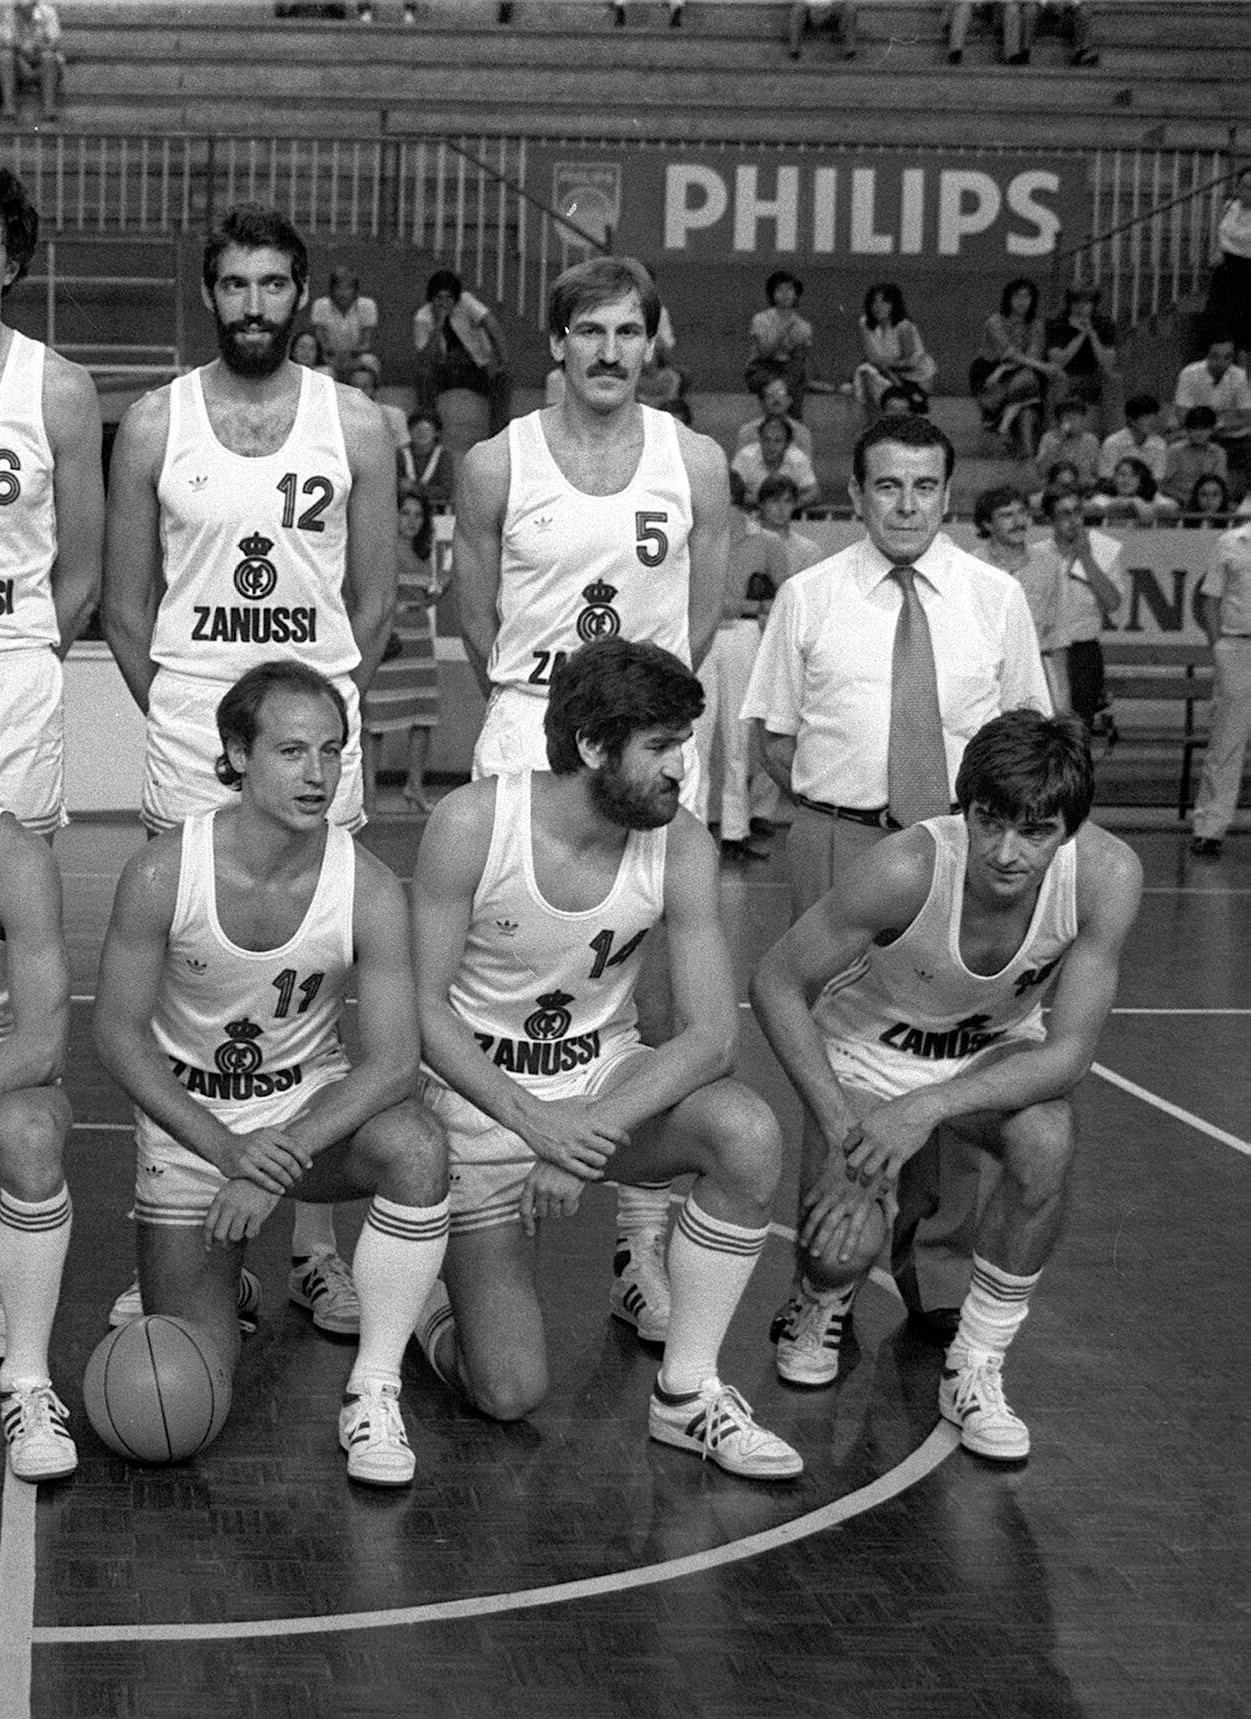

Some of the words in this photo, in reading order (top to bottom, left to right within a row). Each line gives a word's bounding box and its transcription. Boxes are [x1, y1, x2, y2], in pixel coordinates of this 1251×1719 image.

[665, 163, 1061, 255] PHILIPS
[276, 472, 335, 533] 12
[635, 511, 668, 567] 5
[191, 606, 317, 643] ZANUSSI
[272, 968, 325, 1018] 11
